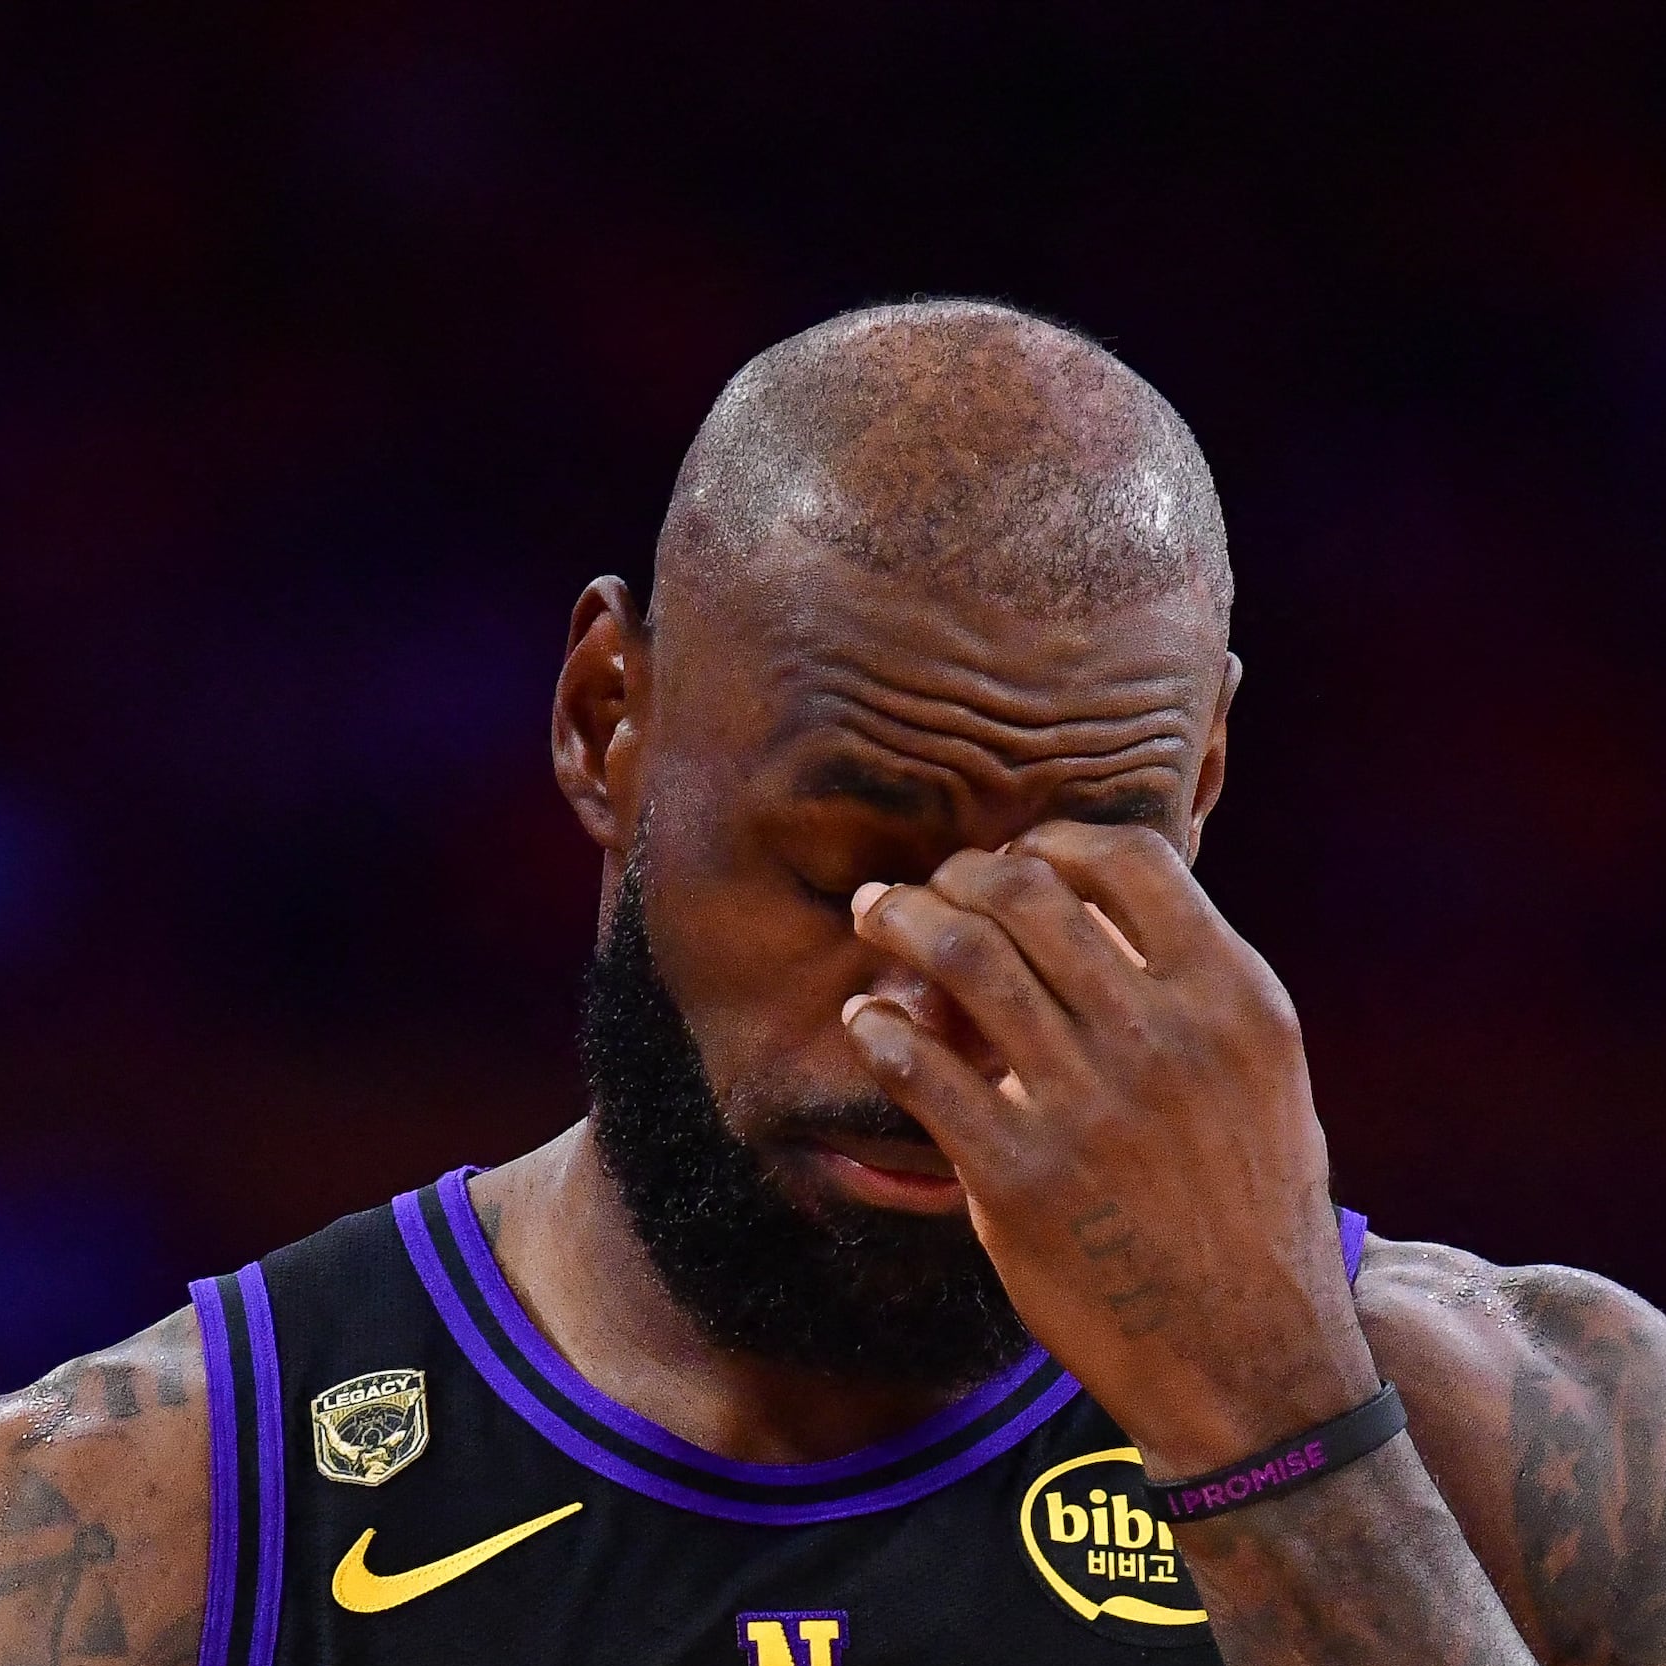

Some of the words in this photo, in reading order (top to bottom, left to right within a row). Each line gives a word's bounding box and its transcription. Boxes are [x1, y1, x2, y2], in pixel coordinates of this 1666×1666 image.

[323, 1376, 411, 1410] LEGACY
[1181, 1440, 1327, 1514] PROMISE
[1088, 1549, 1179, 1583] 비비고
